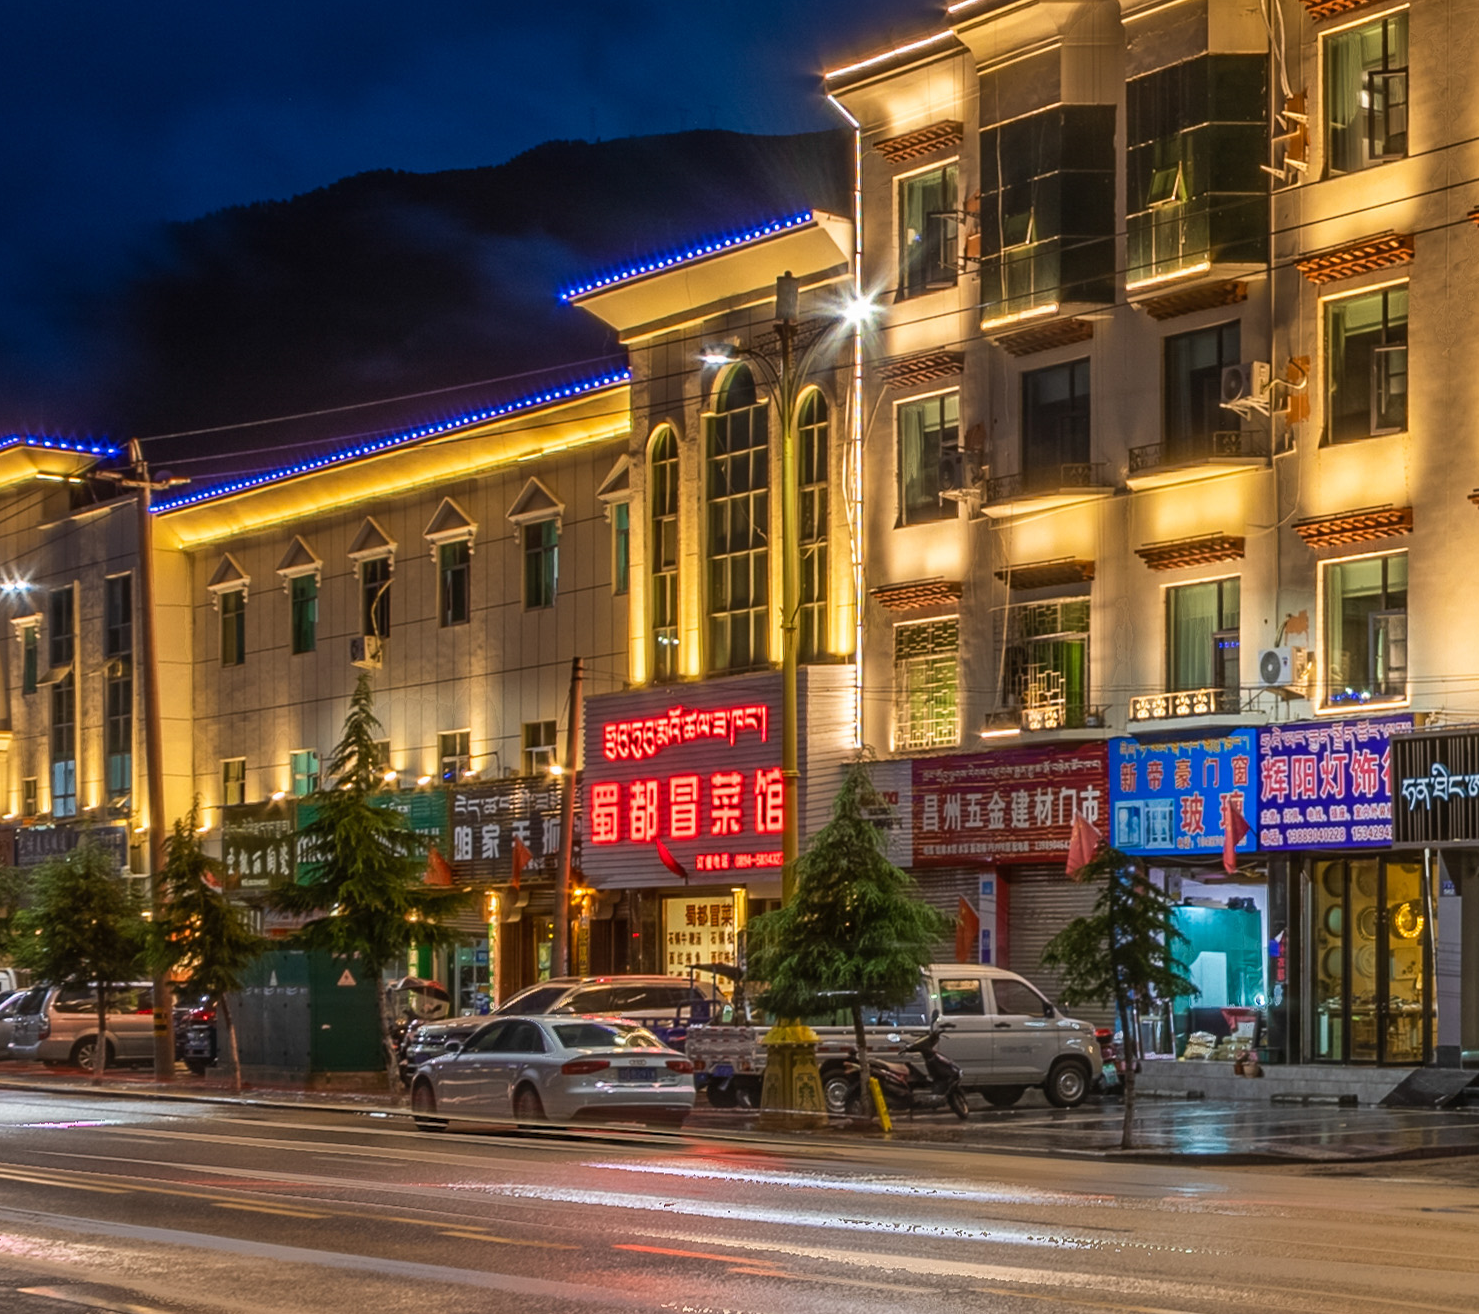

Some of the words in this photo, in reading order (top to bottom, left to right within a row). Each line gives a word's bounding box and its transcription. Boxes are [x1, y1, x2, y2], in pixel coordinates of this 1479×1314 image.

[1120, 753, 1250, 793] 新帝豪门窗
[590, 767, 784, 844] 蜀都冒菜馆
